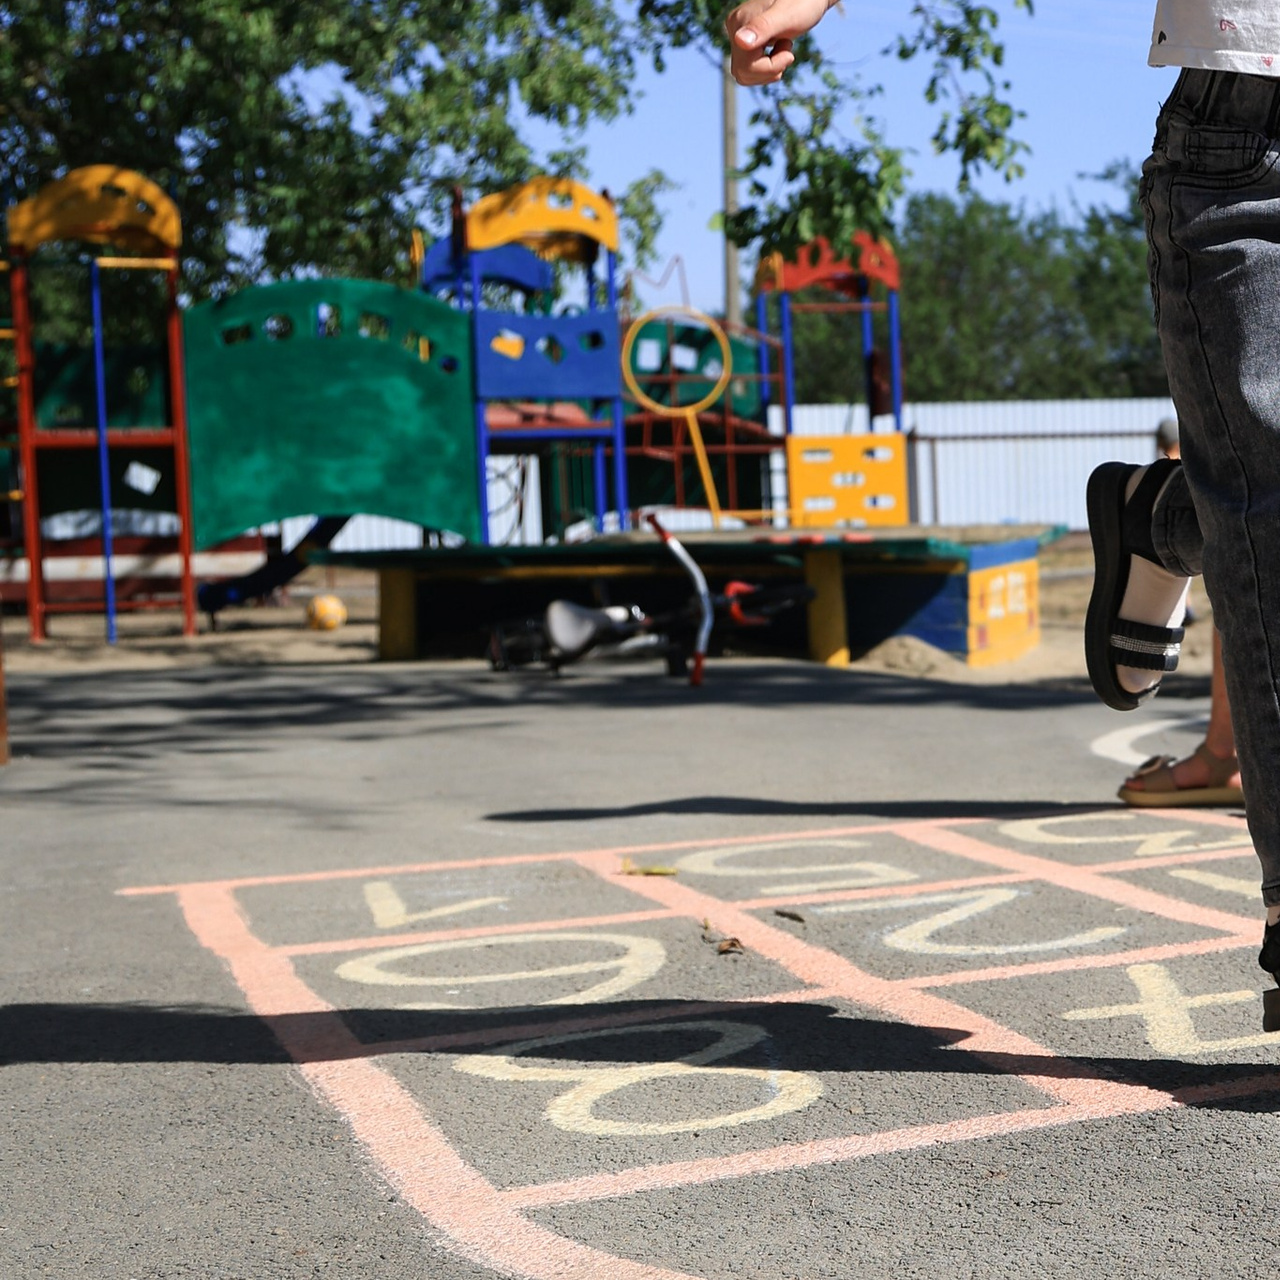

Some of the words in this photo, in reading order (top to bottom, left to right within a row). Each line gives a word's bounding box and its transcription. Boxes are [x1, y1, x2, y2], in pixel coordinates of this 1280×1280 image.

[676, 839, 918, 895] 5
[362, 880, 511, 928] 1
[811, 888, 1128, 955] 2
[452, 1020, 824, 1136] 8
